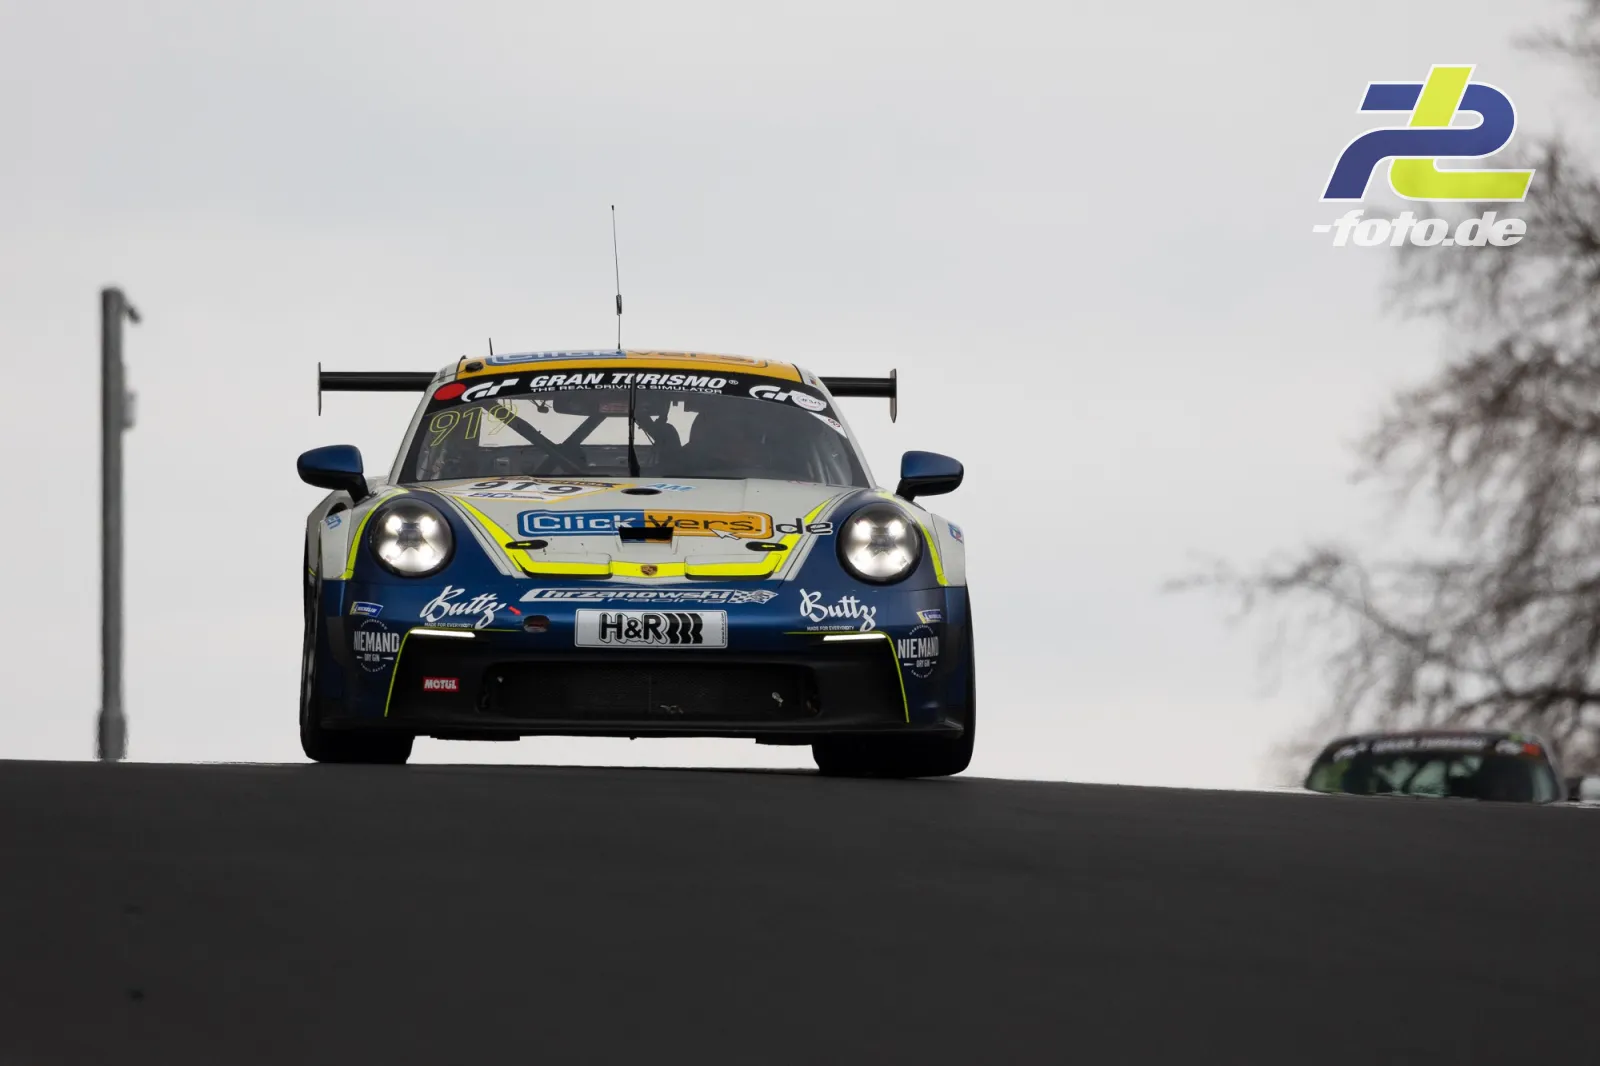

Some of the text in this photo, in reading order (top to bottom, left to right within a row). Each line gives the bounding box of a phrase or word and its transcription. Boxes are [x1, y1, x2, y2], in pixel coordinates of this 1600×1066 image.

[530, 373, 605, 387] GRAN
[649, 385, 723, 394] SIMULATOR
[429, 404, 518, 447] 919
[468, 480, 583, 495] 919
[533, 514, 637, 530] Click
[519, 588, 734, 602] Chrzanowski
[419, 585, 507, 629] Buttz
[799, 588, 877, 632] Buttz
[600, 612, 664, 642] H&R
[353, 631, 400, 652] NIEMAND
[897, 636, 939, 659] NIEMAND
[364, 653, 380, 662] DRY GIN
[916, 660, 924, 668] DRY
[424, 679, 457, 690] MOTUL
